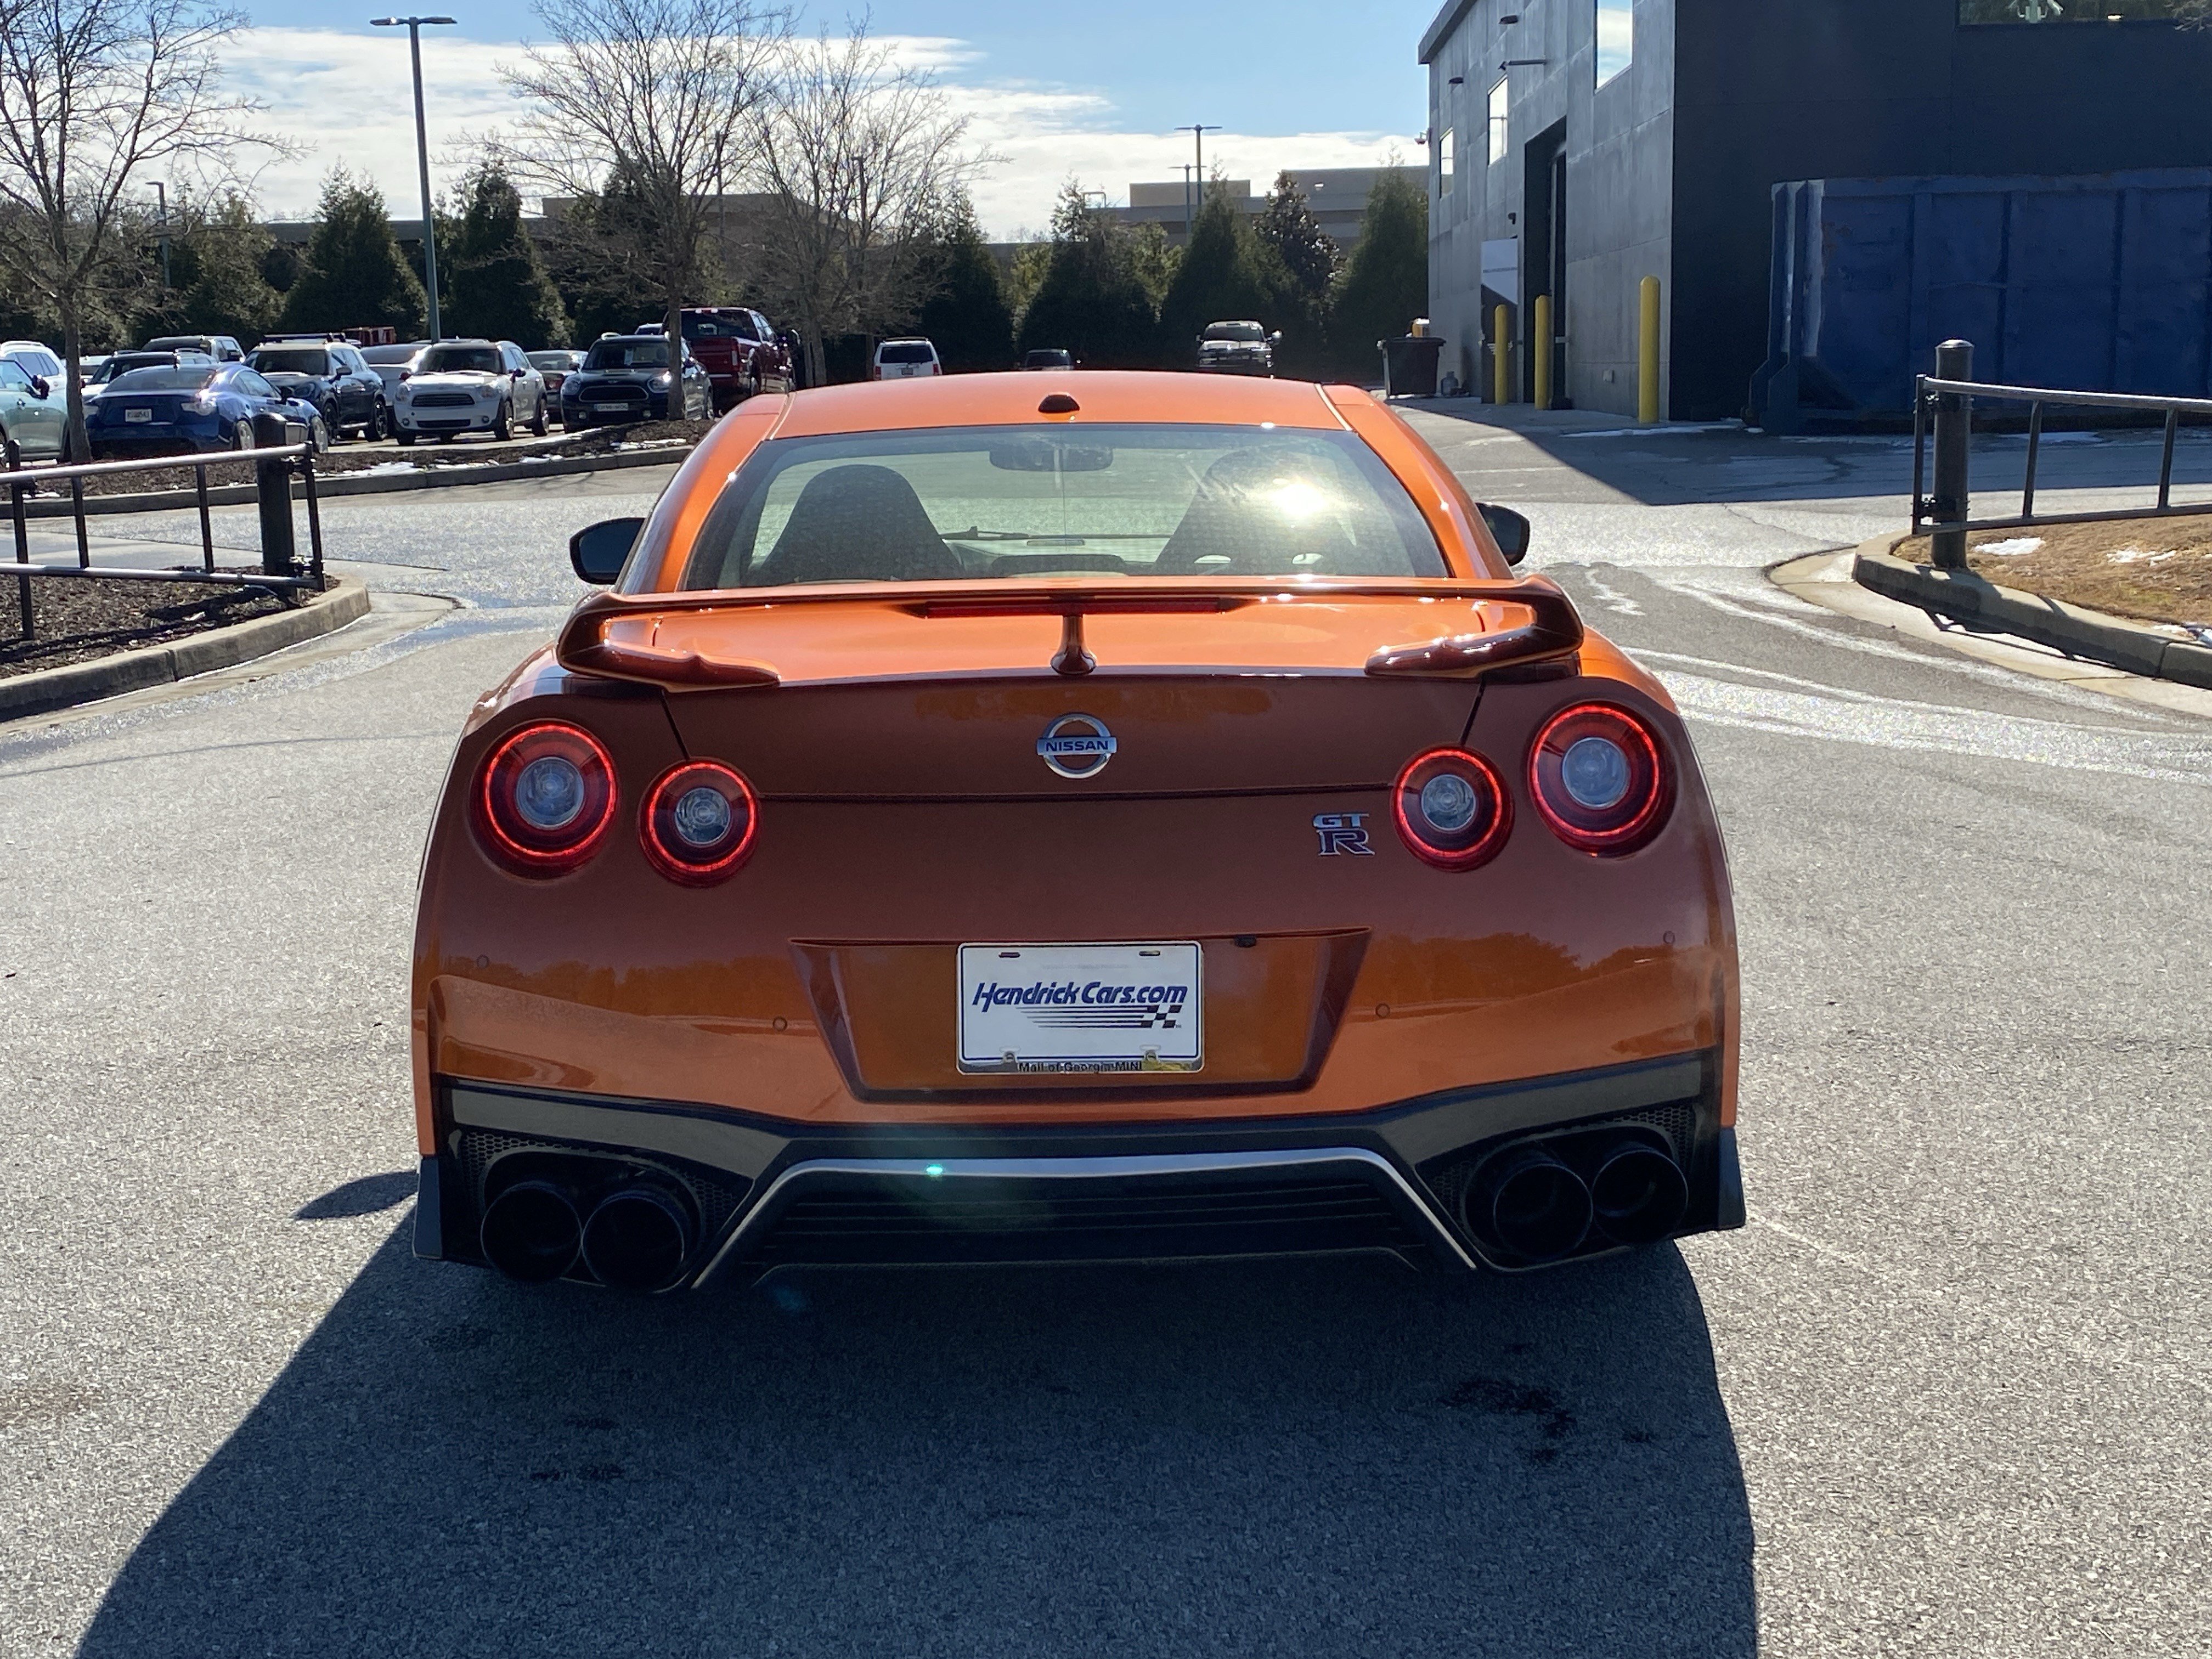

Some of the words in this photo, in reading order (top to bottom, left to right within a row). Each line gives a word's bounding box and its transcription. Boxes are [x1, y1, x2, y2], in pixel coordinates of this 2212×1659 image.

[1046, 741, 1108, 752] NISSAN
[1316, 828, 1375, 855] R
[1019, 1062, 1043, 1072] Mall
[1049, 1062, 1063, 1072] of
[1064, 1062, 1114, 1074] Georgia
[1115, 1061, 1142, 1071] MINI
